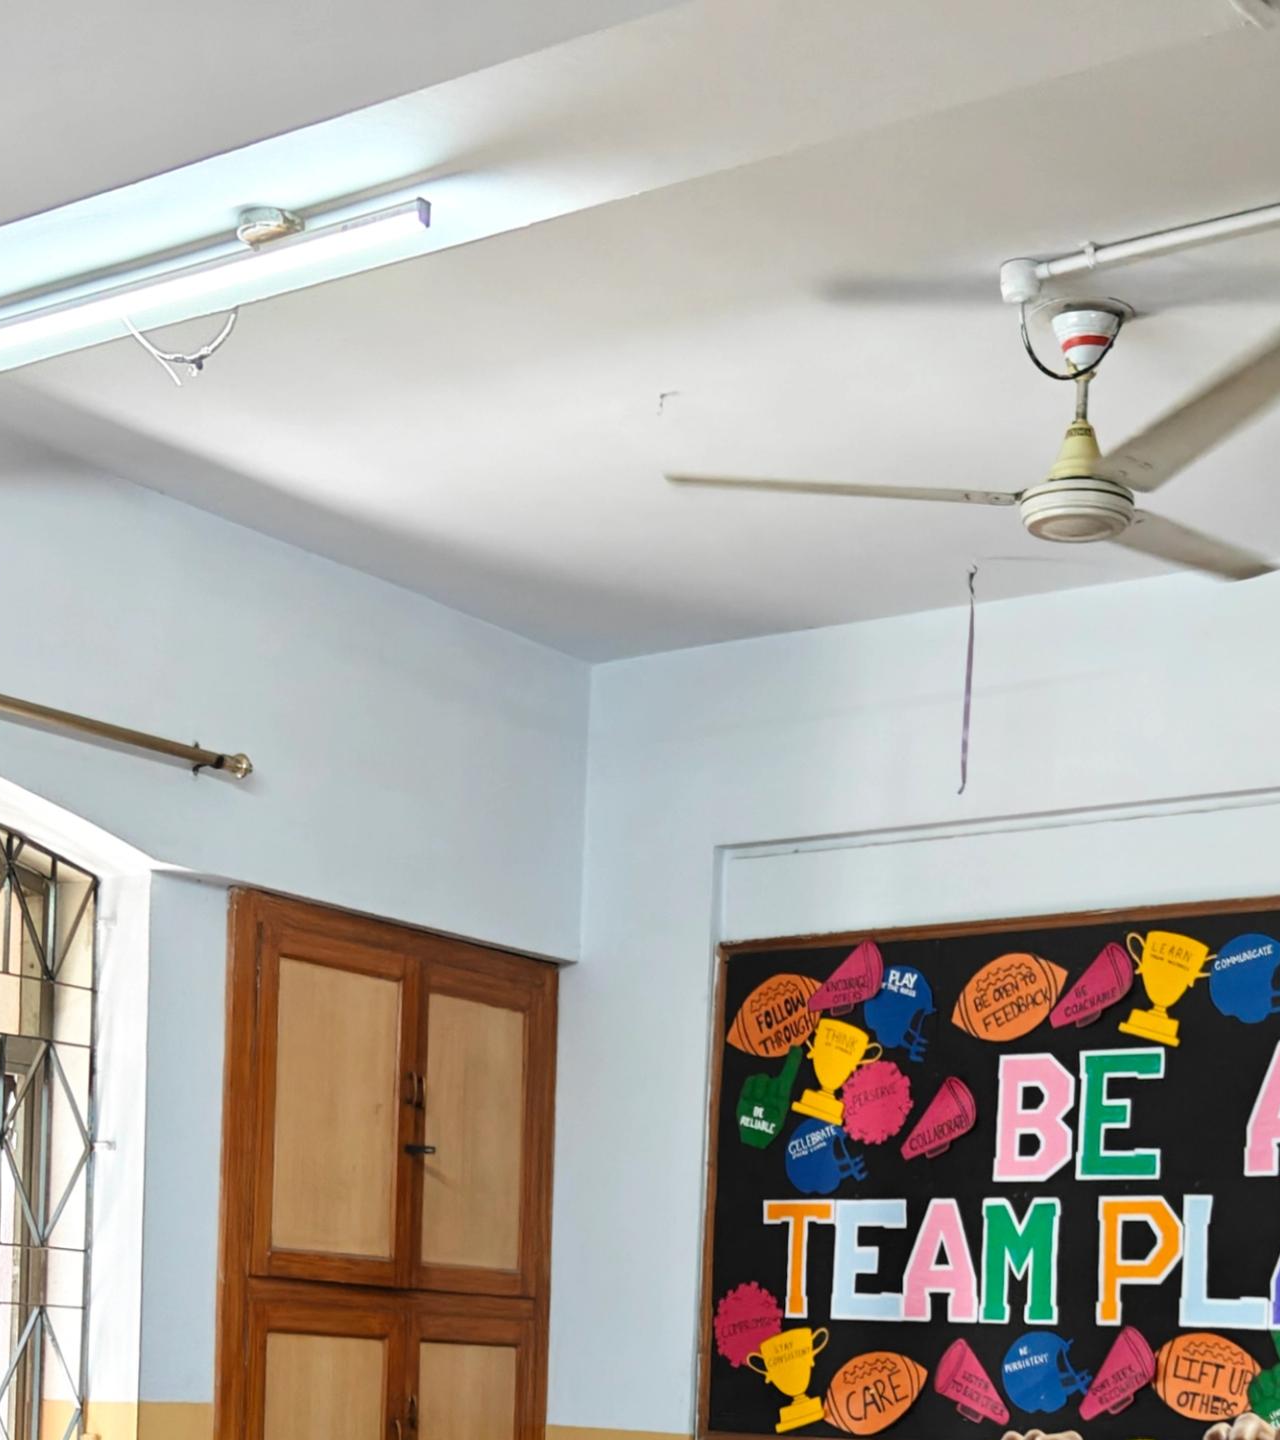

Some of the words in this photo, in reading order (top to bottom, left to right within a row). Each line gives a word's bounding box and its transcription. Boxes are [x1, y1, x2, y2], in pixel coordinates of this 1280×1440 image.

[1150, 943, 1194, 963] LEARN
[1214, 943, 1274, 971] COMMUNICATE
[887, 969, 919, 989] PLAY
[755, 991, 807, 1034] FOLLOW
[973, 989, 992, 1013] BE
[992, 981, 1020, 1004] OPEN
[981, 986, 1051, 1033] FEEDBACK
[1063, 986, 1118, 1018] COACHABLE
[758, 1012, 816, 1056] THROUGH
[825, 1027, 858, 1048] THINK
[992, 1046, 1166, 1183] BE
[787, 1124, 837, 1155] CELEBRATE
[762, 1196, 1061, 1326] TEAM
[1003, 1352, 1050, 1374] PERSISTENT
[1172, 1355, 1225, 1389] LIFT
[1228, 1371, 1257, 1397] UP
[845, 1368, 910, 1421] CARE
[1176, 1390, 1239, 1417] OTHERS
